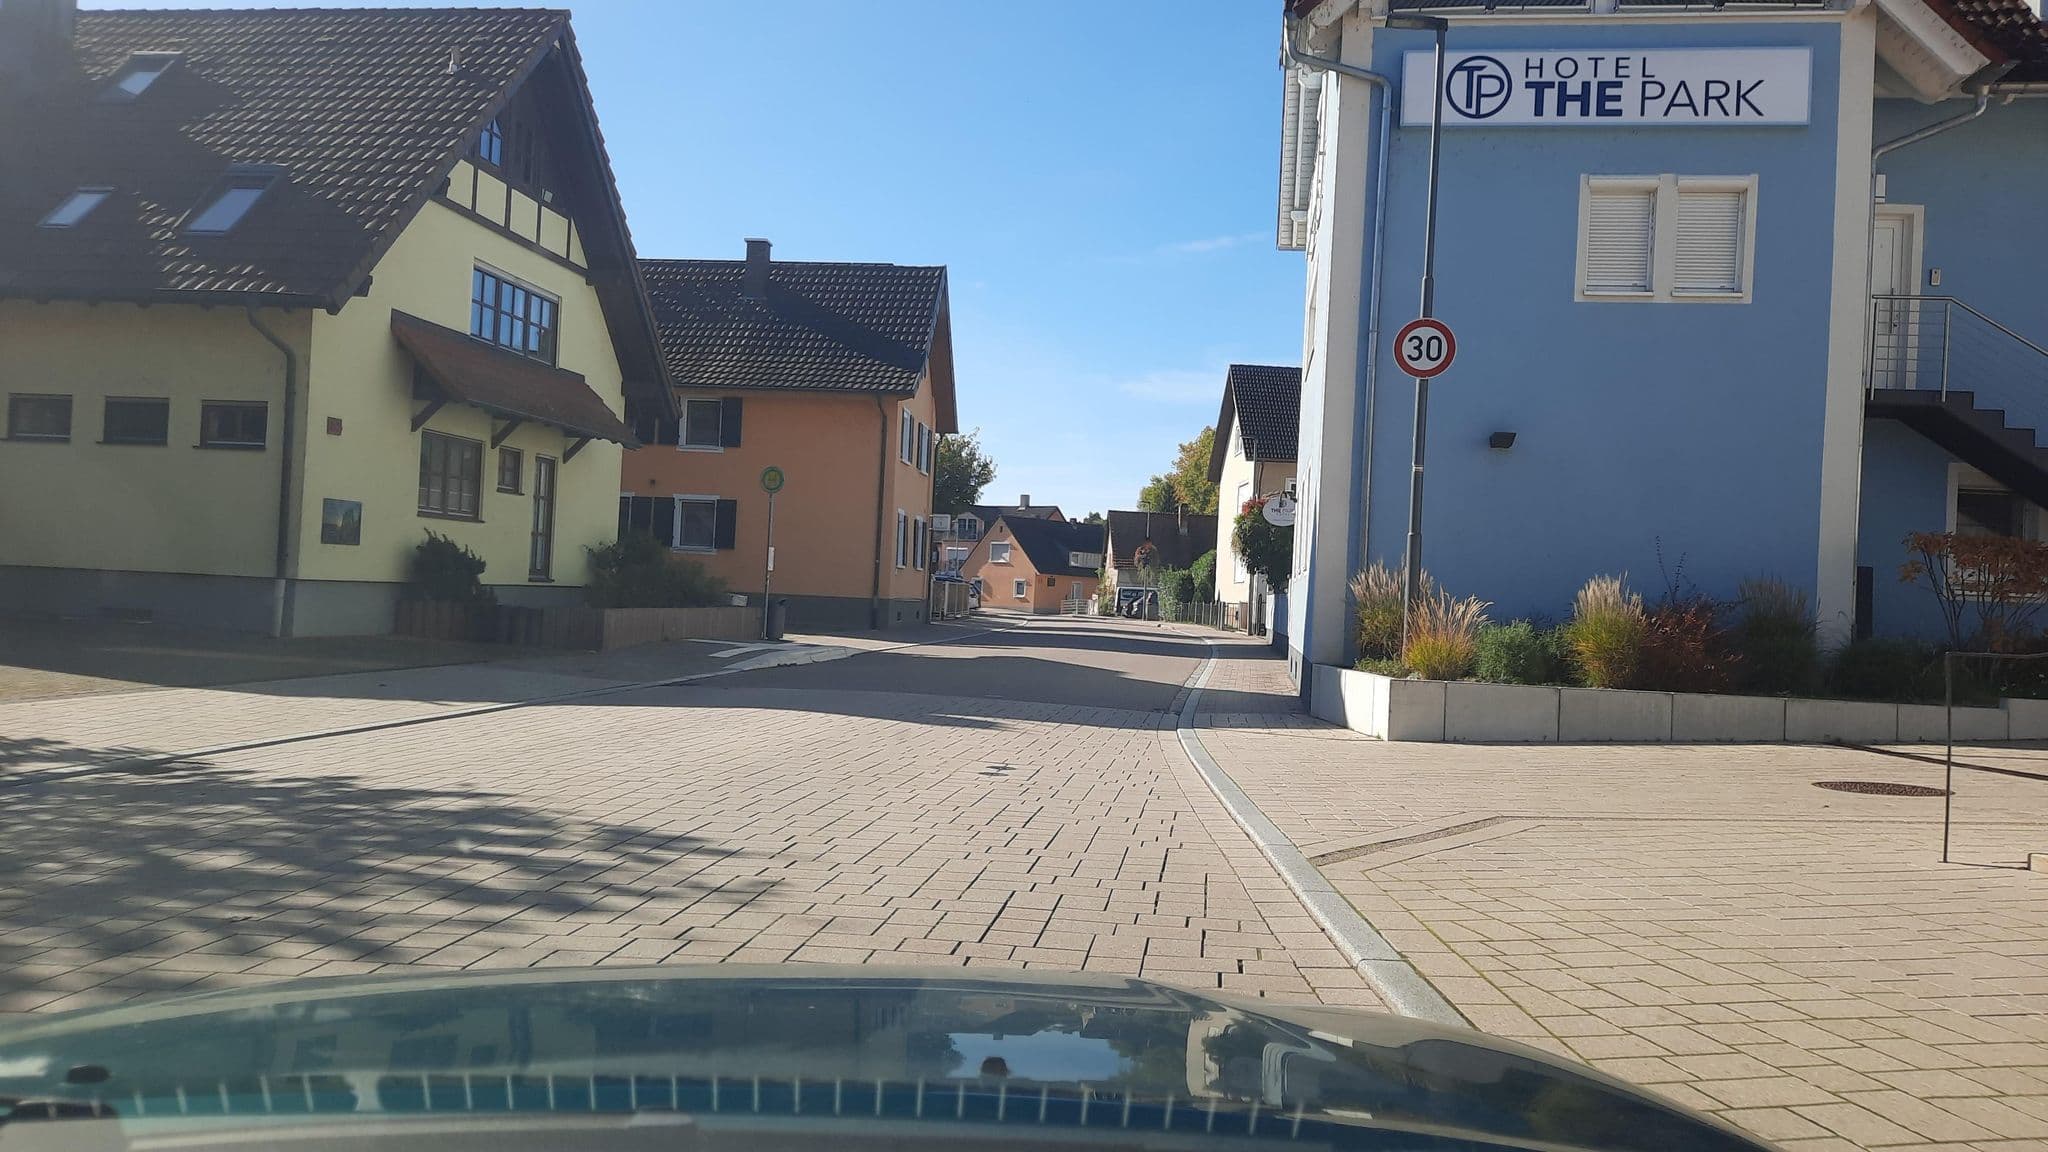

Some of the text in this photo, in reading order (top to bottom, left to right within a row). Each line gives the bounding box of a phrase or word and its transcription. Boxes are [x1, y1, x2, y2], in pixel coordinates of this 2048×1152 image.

[1524, 56, 1656, 79] HOTEL
[1524, 79, 1765, 118] THE PARK
[1406, 335, 1443, 362] 30
